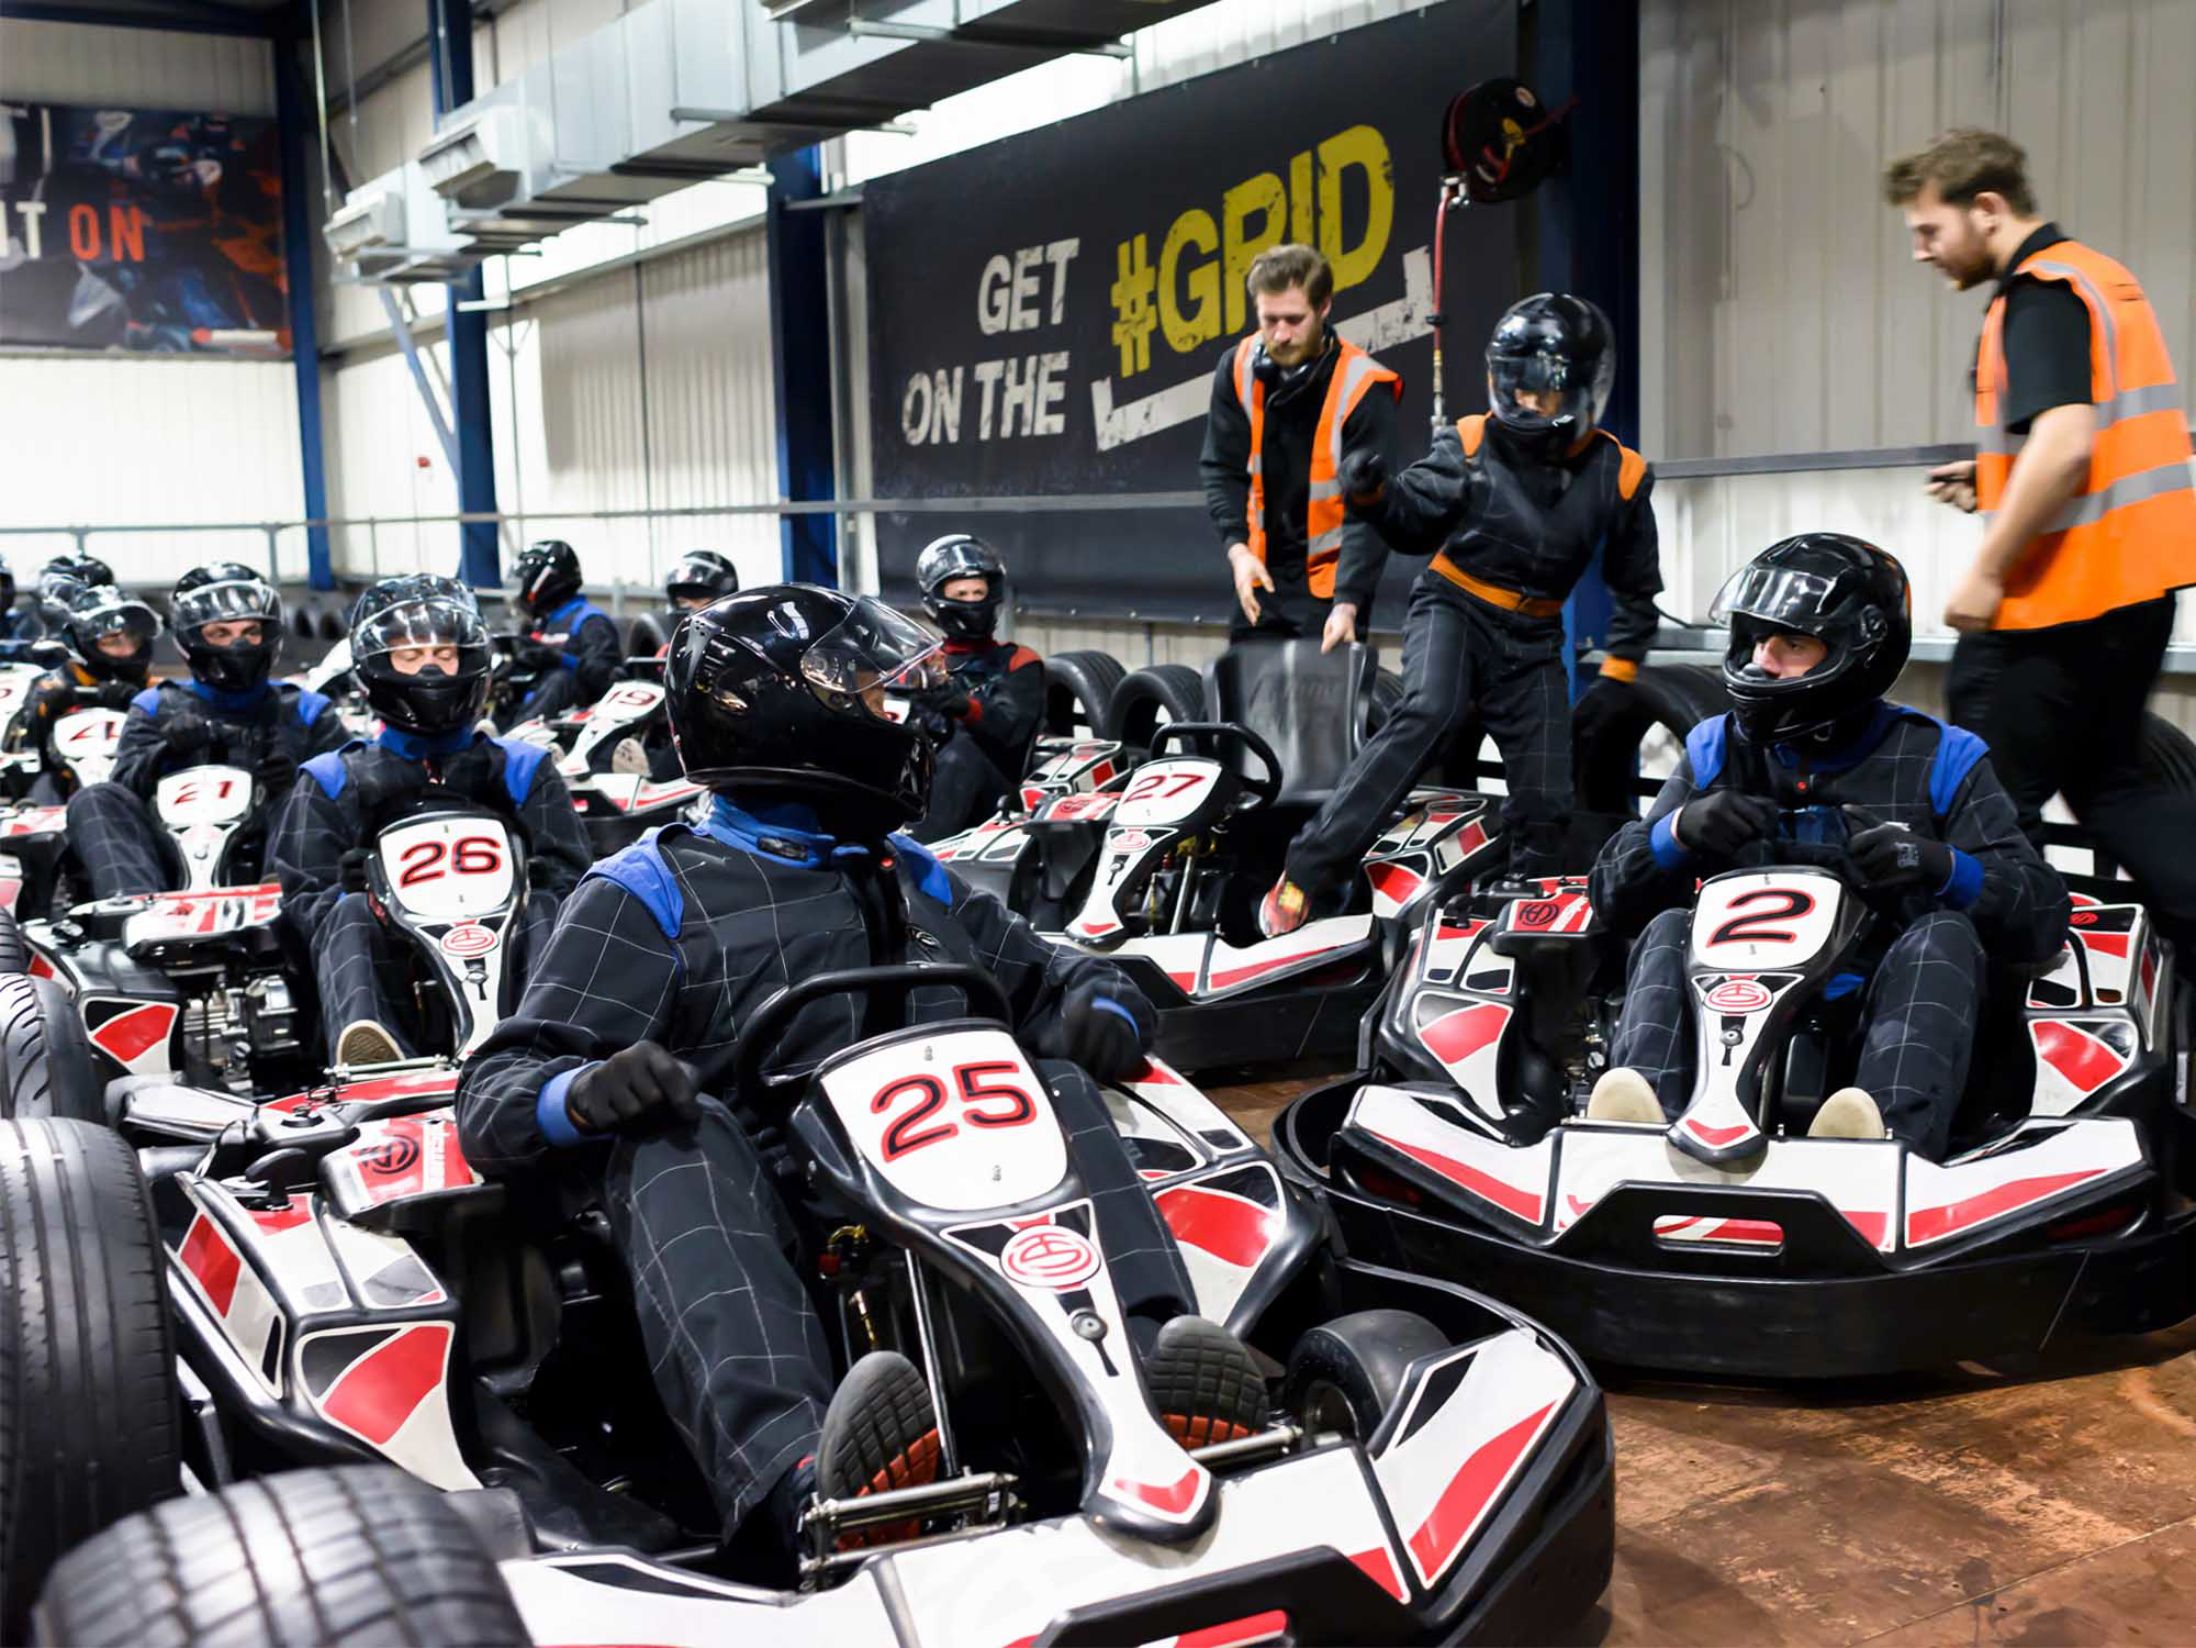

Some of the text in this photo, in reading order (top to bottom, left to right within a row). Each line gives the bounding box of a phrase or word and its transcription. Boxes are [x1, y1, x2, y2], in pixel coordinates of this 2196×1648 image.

[69, 203, 145, 262] ON
[1111, 124, 1395, 379] #GRID
[977, 237, 1080, 336] GET
[902, 351, 1070, 446] ON THE
[606, 690, 657, 706] 19
[174, 781, 233, 806] 21
[1122, 773, 1206, 803] 27
[399, 835, 502, 889] 26
[1706, 887, 1817, 949] 2
[870, 1061, 1037, 1164] 25
